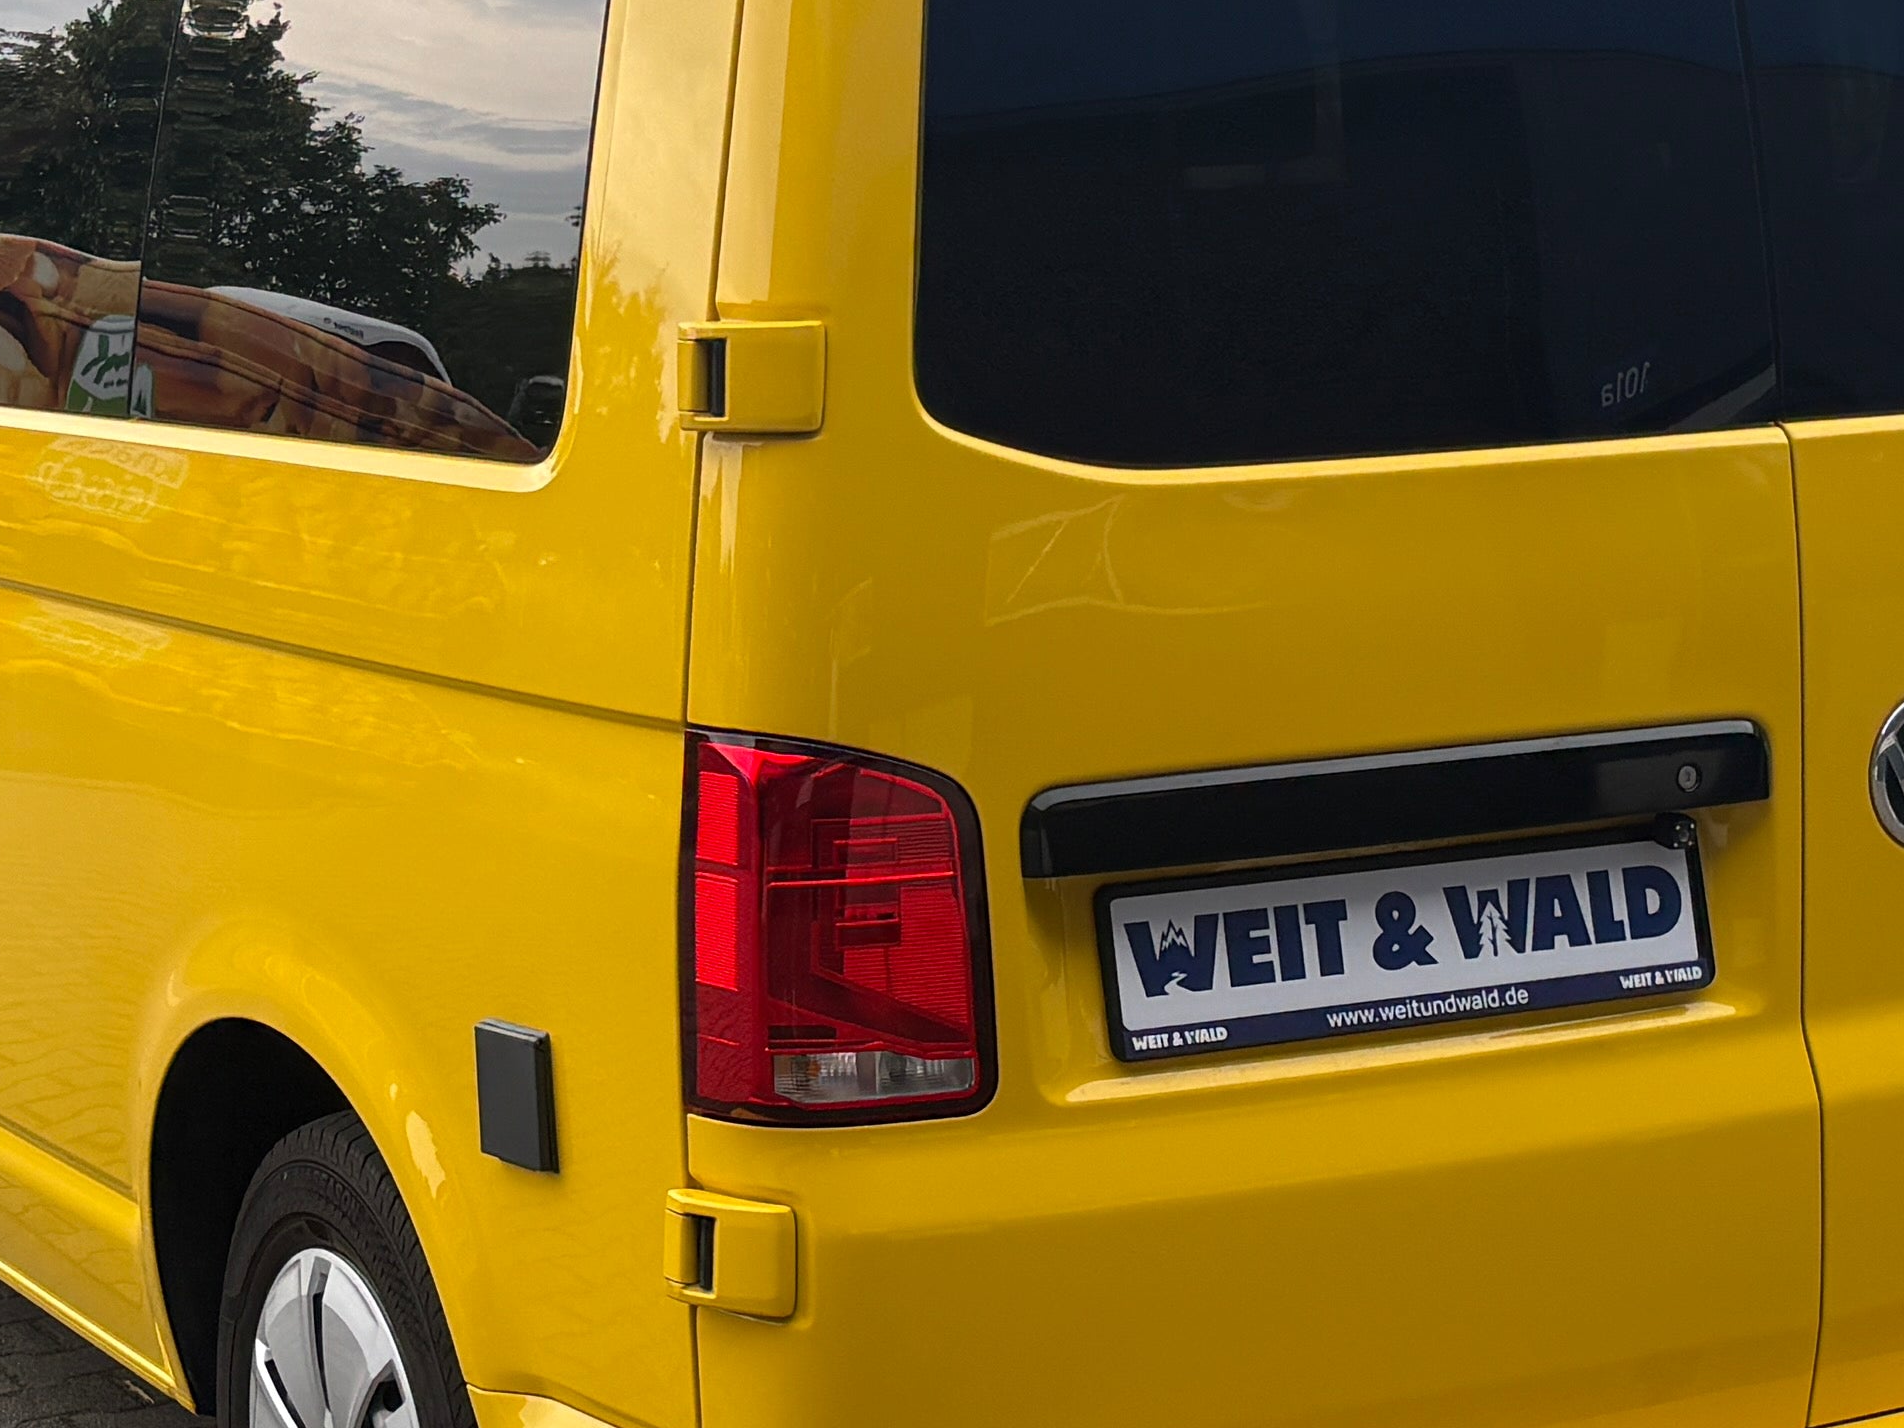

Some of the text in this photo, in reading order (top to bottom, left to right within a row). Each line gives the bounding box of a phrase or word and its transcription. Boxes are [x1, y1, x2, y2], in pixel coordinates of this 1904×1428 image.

[1124, 865, 1682, 998] WEIT & WALD
[1619, 966, 1703, 989] WEIT & WALD
[1326, 987, 1529, 1028] www.weitundwald.de
[1132, 1027, 1228, 1051] WEIT & WALD
